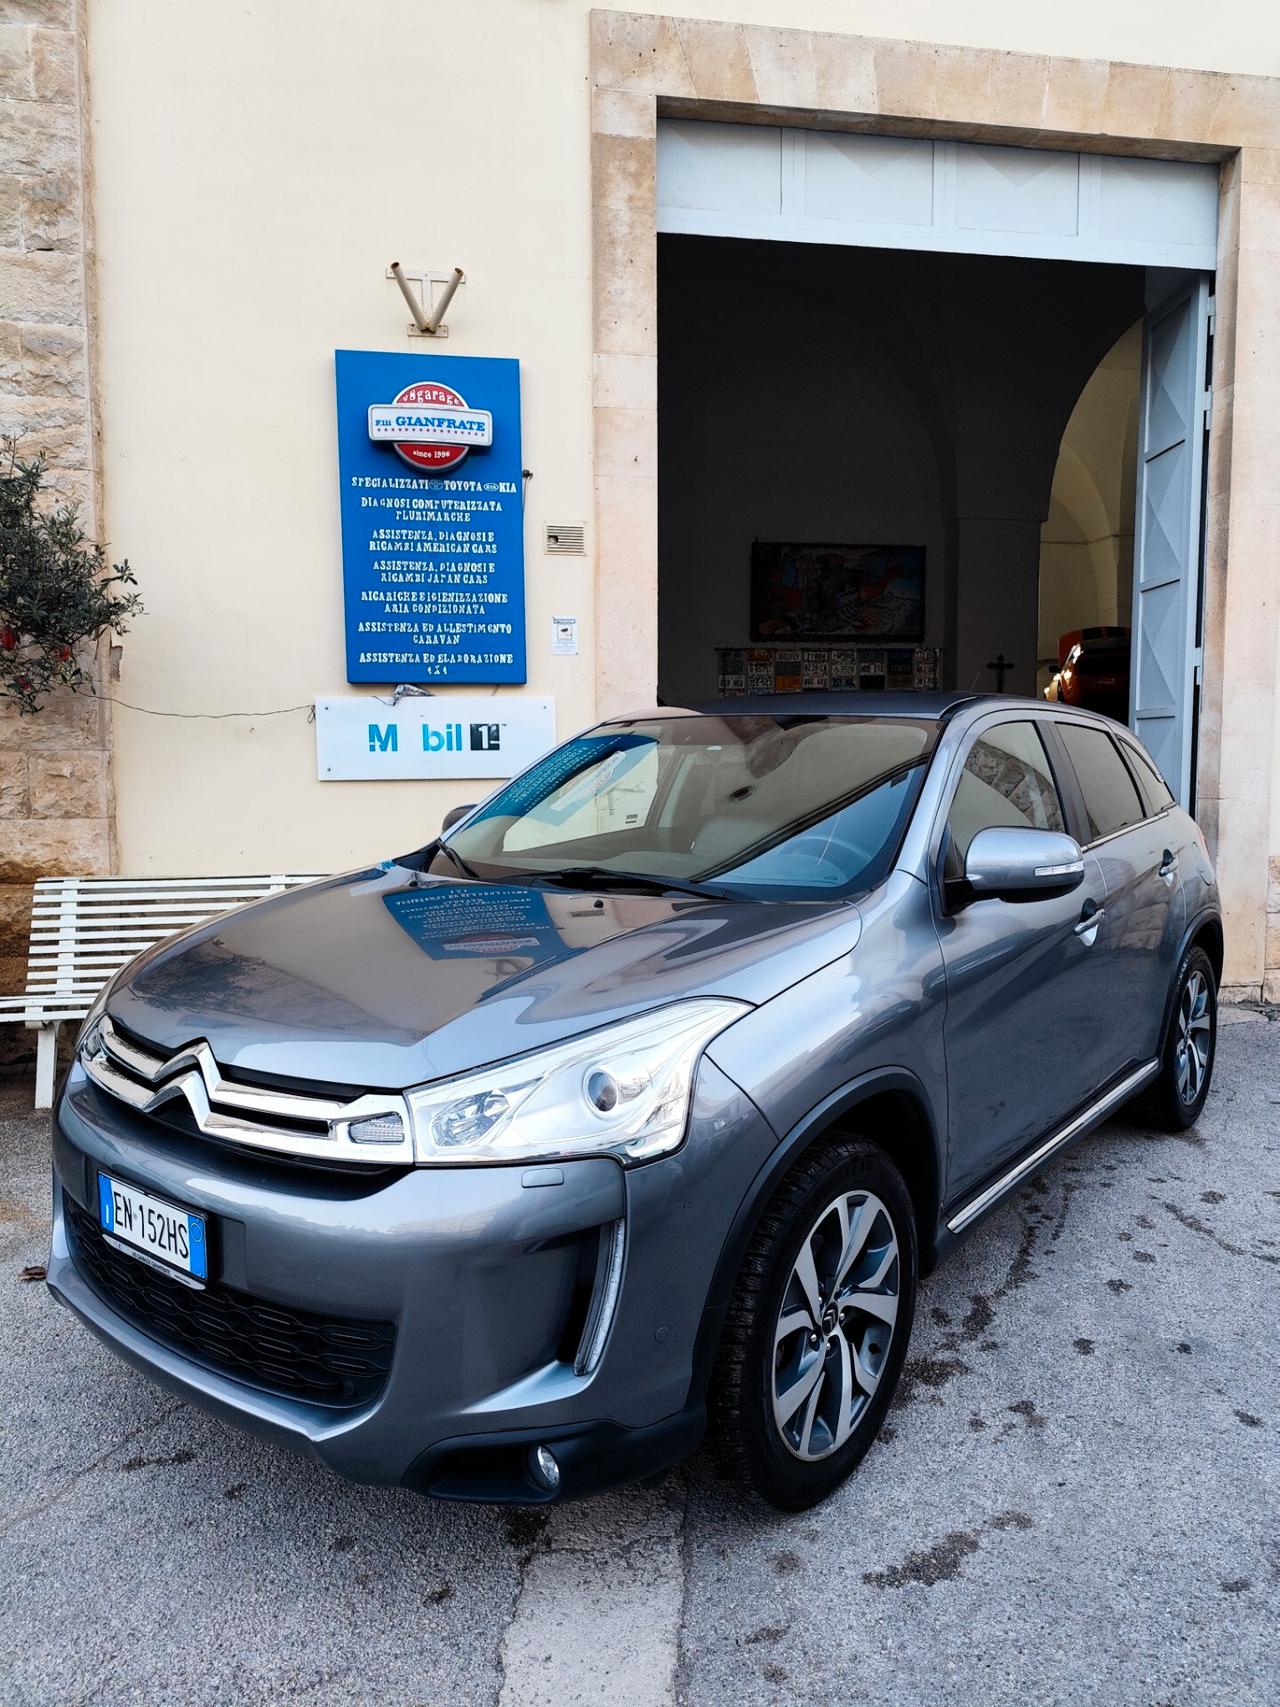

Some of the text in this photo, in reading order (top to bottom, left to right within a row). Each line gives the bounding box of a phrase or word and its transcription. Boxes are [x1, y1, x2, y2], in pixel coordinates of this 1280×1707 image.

[395, 416, 486, 432] GIANFRATE
[412, 449, 432, 458] since
[444, 480, 482, 492] TOYOTA
[498, 482, 517, 493] KIA
[361, 496, 410, 508] DIAGNOSI
[372, 528, 495, 542] ASSISTENZA, DIAGNOSI E
[369, 541, 498, 554] RICAMBI AMERICAN CARS
[372, 560, 495, 573] ASSISTENZA, DIAGNOSI E
[380, 572, 425, 583] RICAMBI
[462, 574, 488, 584] CARS
[361, 591, 508, 604] RICARICHE E IGIENIZZAZIONE
[384, 604, 486, 615] ARIA CONDIZIONATA
[358, 622, 512, 634] ASSISTENZA ED ALLESTIMENTO
[413, 635, 460, 645] CARAVAN
[359, 652, 513, 664] ASSISTENZA ED ELABORAZIONE
[114, 1191, 189, 1259] EN 152HS
